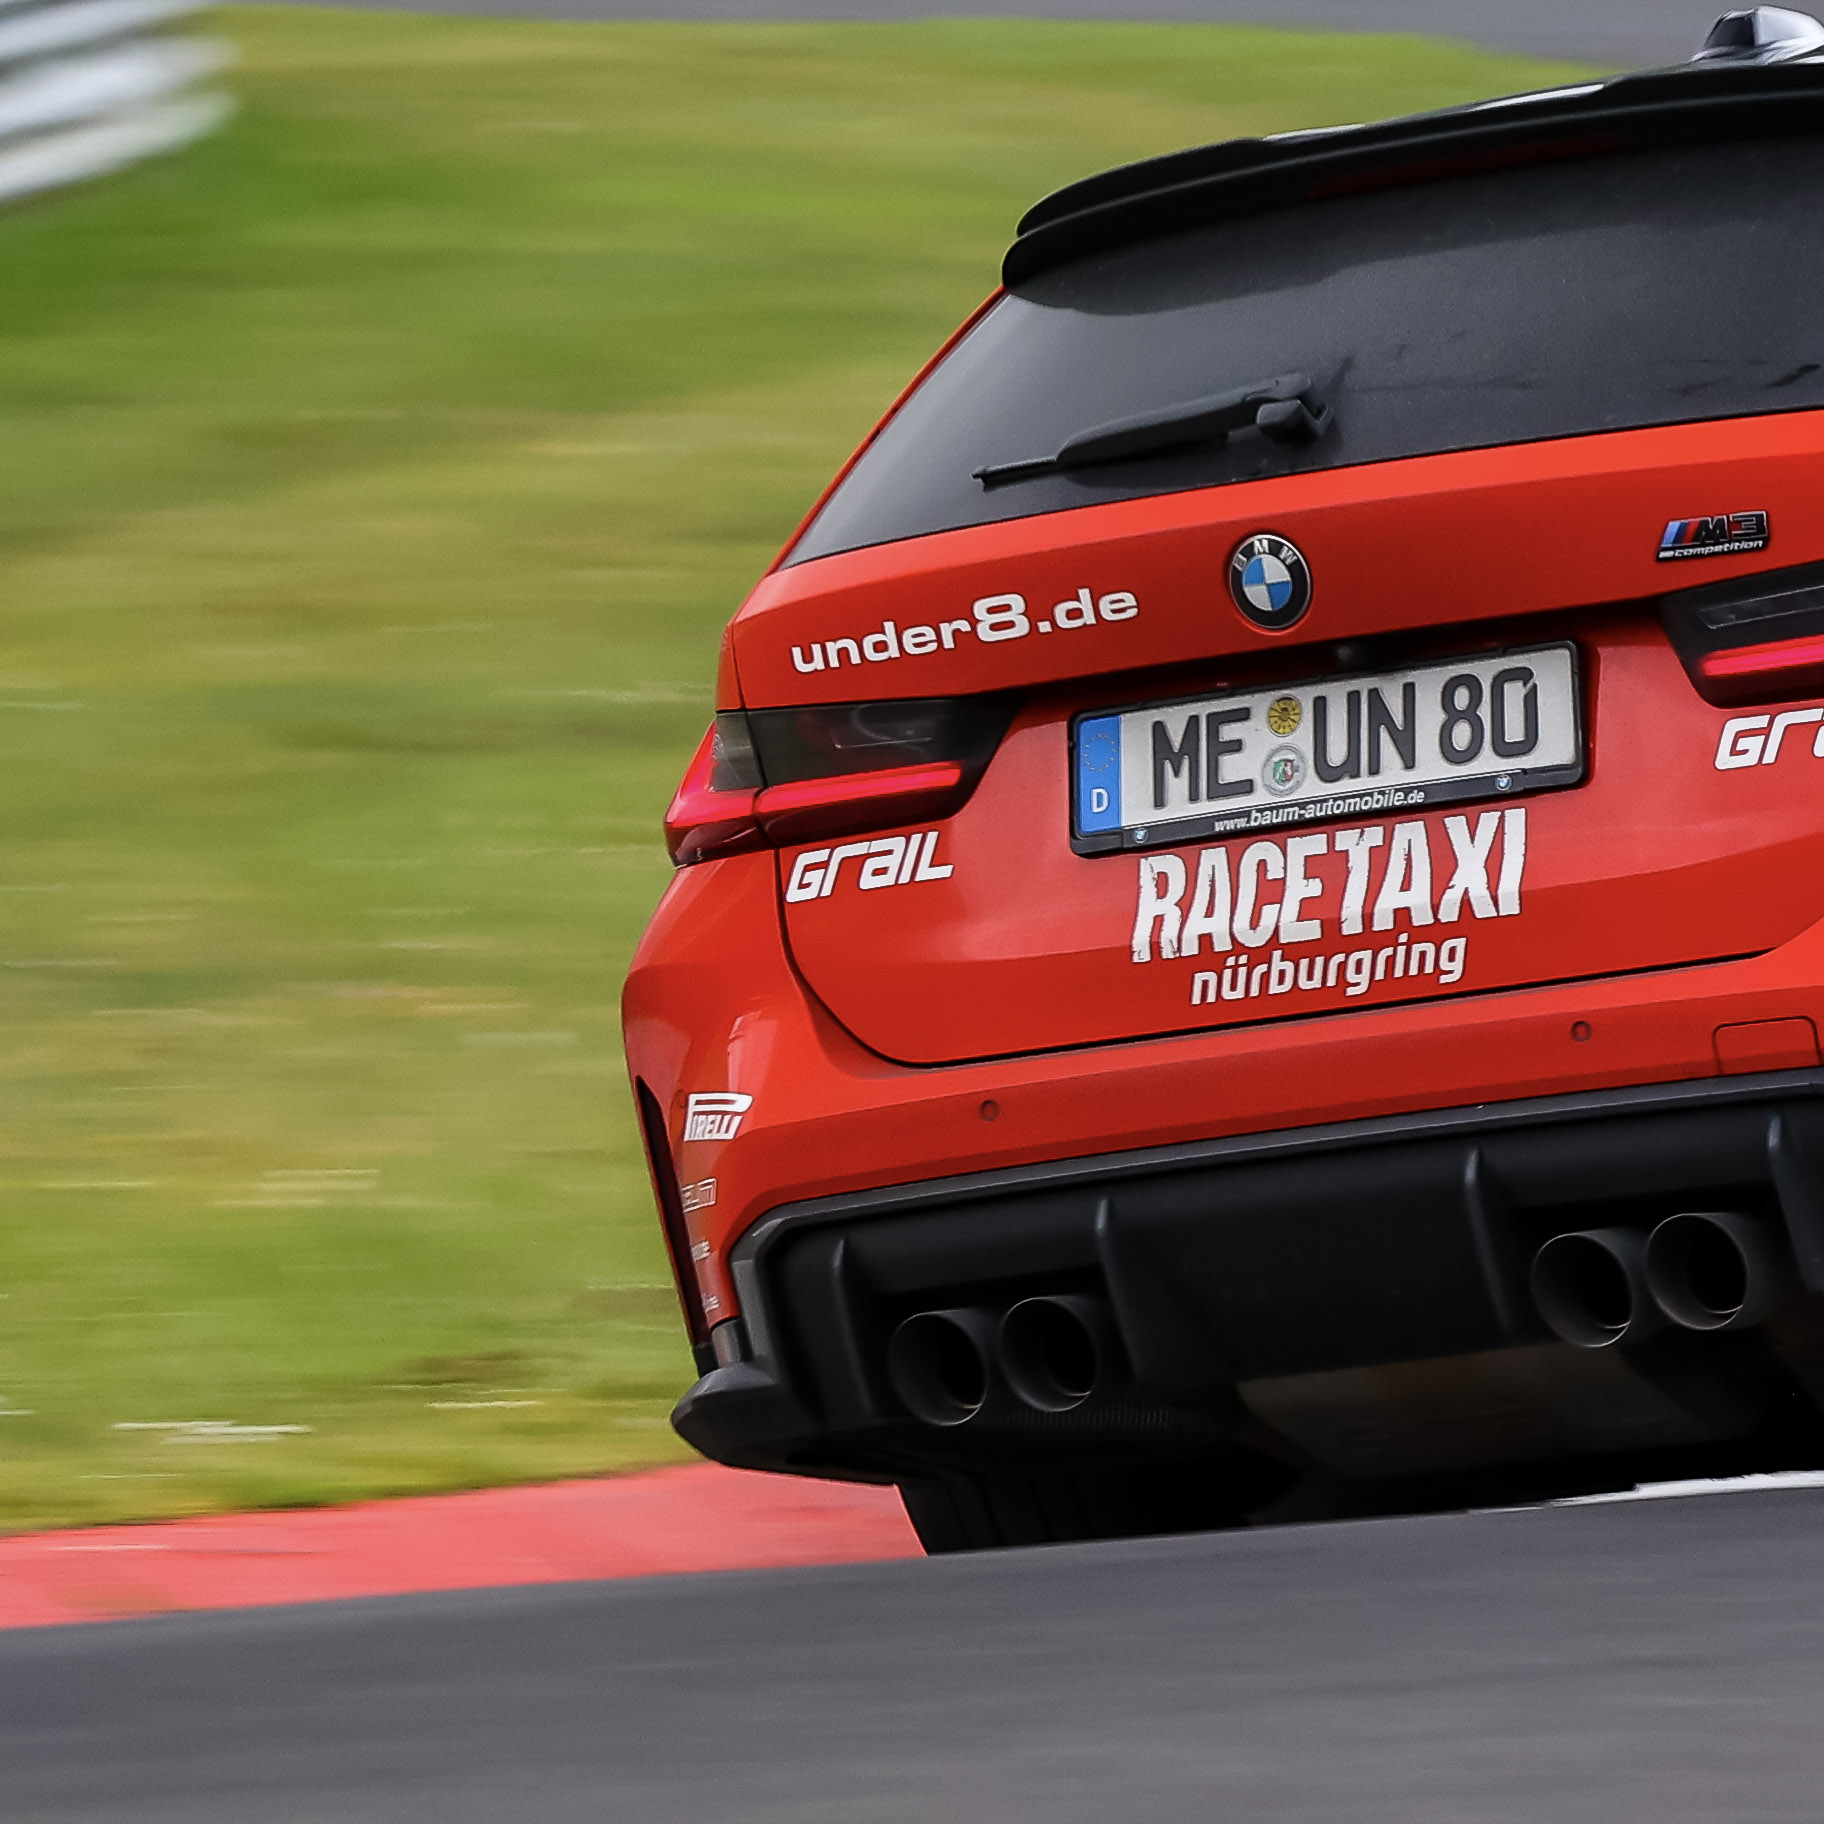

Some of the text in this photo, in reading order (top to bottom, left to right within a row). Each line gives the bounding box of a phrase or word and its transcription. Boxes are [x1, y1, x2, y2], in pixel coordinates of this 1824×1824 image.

[1233, 539, 1298, 572] BMW
[790, 588, 1139, 673] under8.de
[1152, 667, 1540, 809] ME UN 80
[1090, 788, 1109, 813] D
[1213, 789, 1425, 832] www.baum-automobile.de
[1190, 933, 1468, 1005] nürburgring
